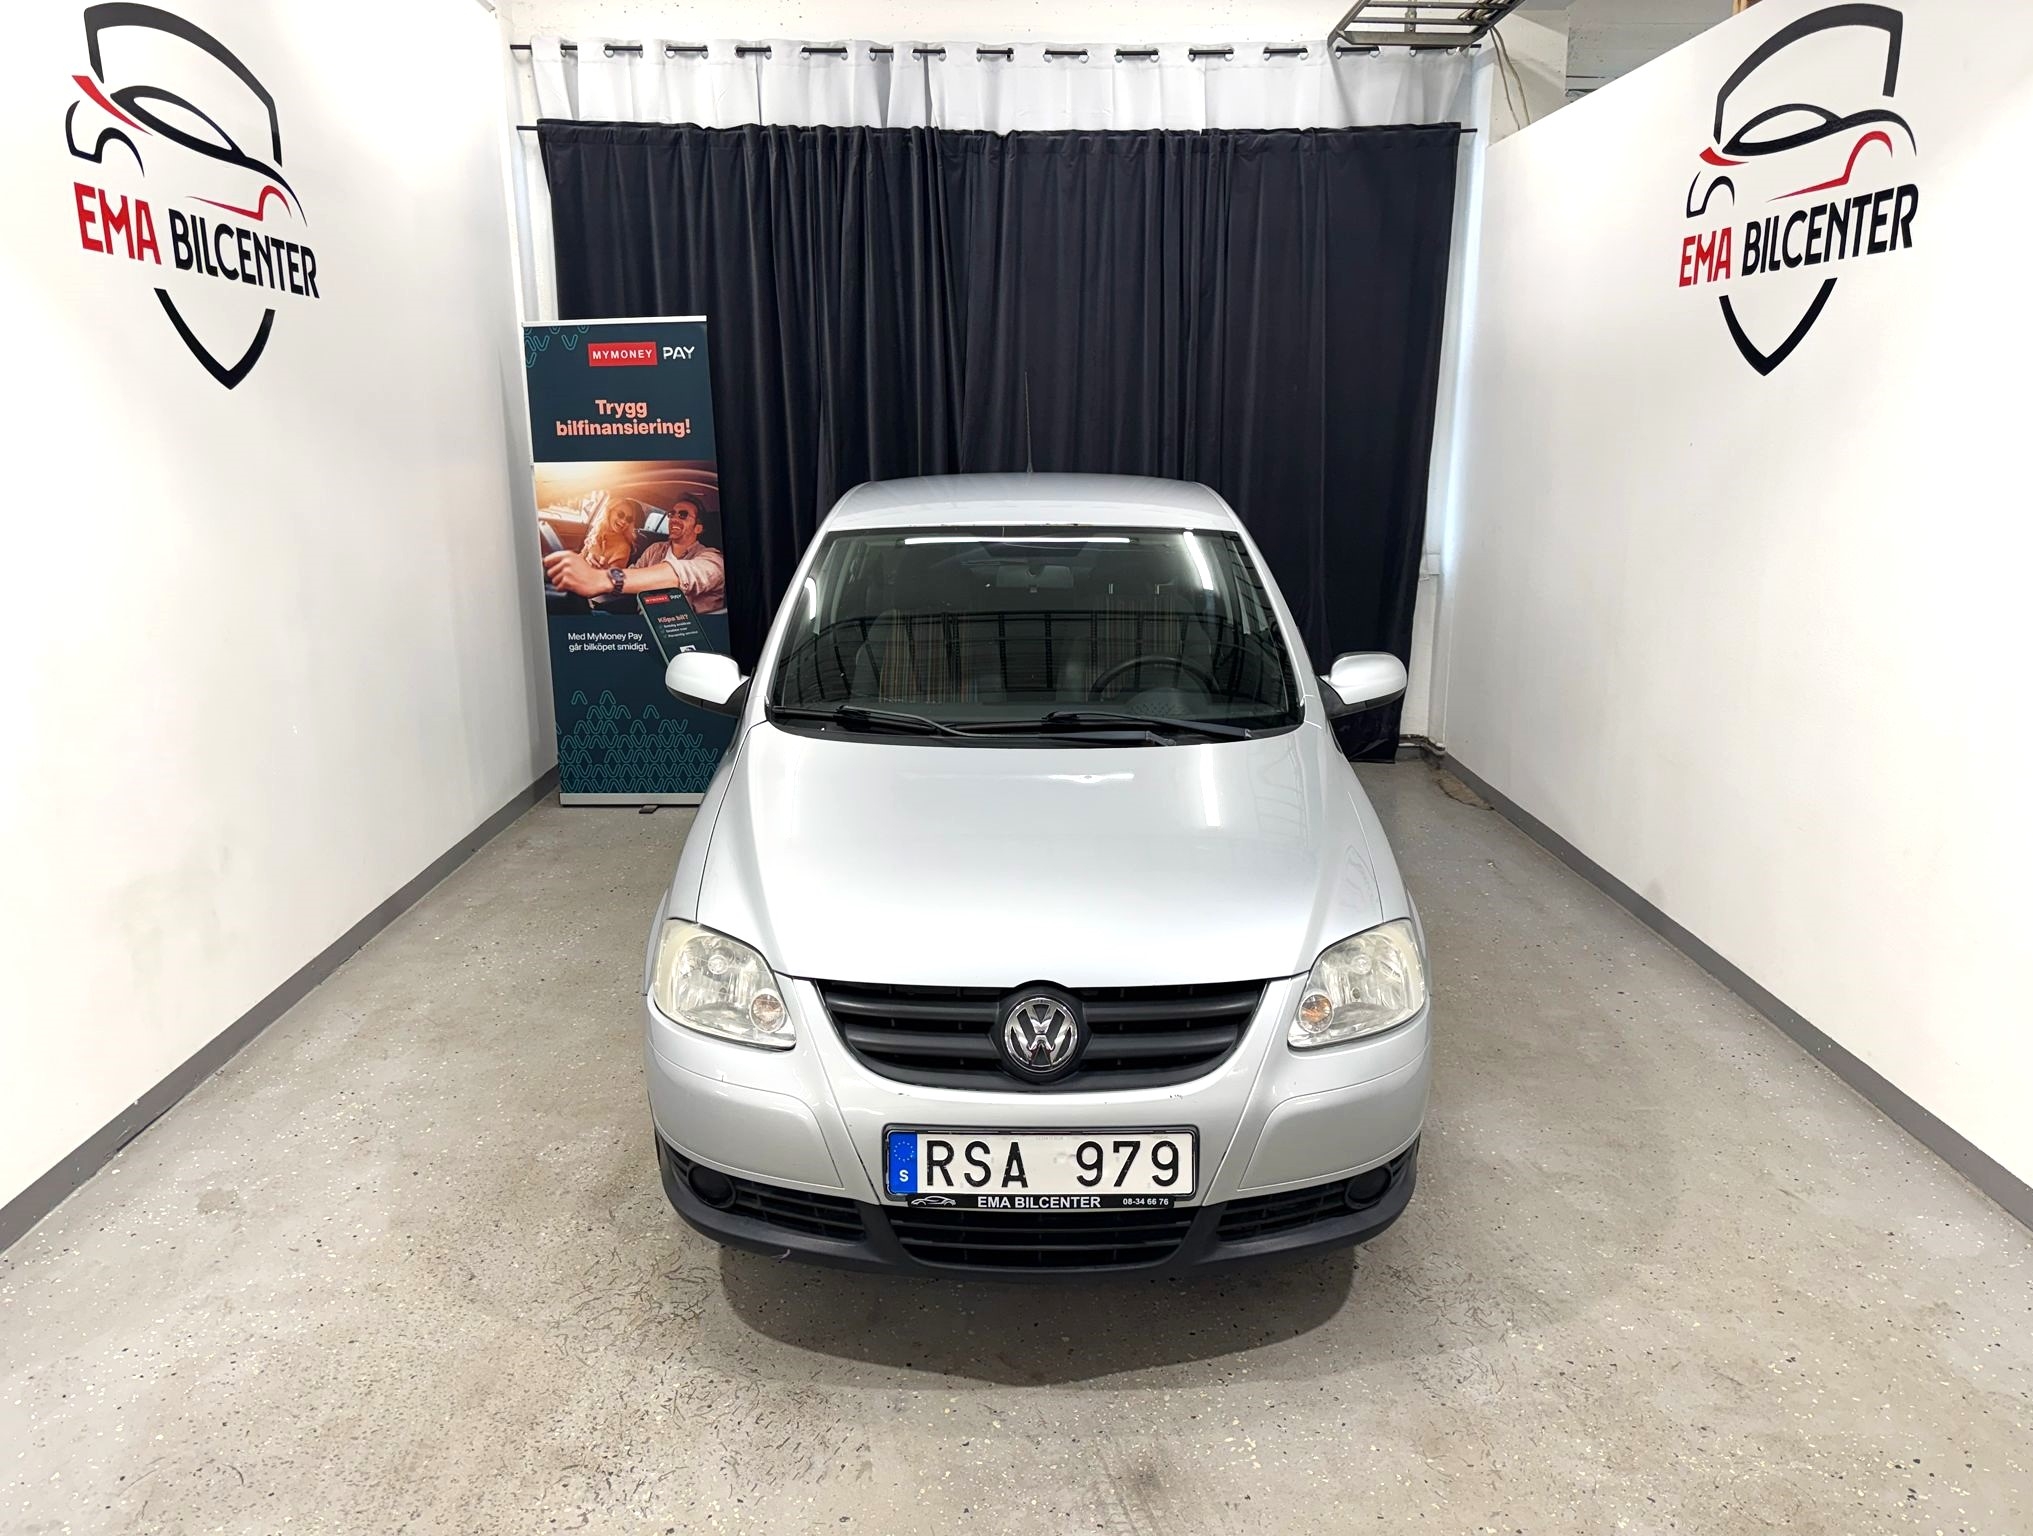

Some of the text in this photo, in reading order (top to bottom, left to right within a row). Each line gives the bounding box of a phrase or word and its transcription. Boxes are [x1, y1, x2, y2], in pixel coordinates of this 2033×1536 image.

[74, 182, 320, 299] EMA BILCENTER
[1679, 183, 1919, 287] EMA BILCENTER
[592, 346, 695, 360] MYMONEY PAY
[595, 399, 647, 418] Trygg
[556, 418, 691, 438] bilfinansiering!
[567, 632, 643, 641] Med MyMoney Pay
[568, 643, 649, 652] går bilköpet smidigt.
[926, 1140, 1180, 1188] RSA 979
[899, 1169, 909, 1182] S
[977, 1196, 1101, 1209] EMA BILCENTER
[1122, 1198, 1145, 1206] 08-34
[1159, 1198, 1169, 1206] 76
